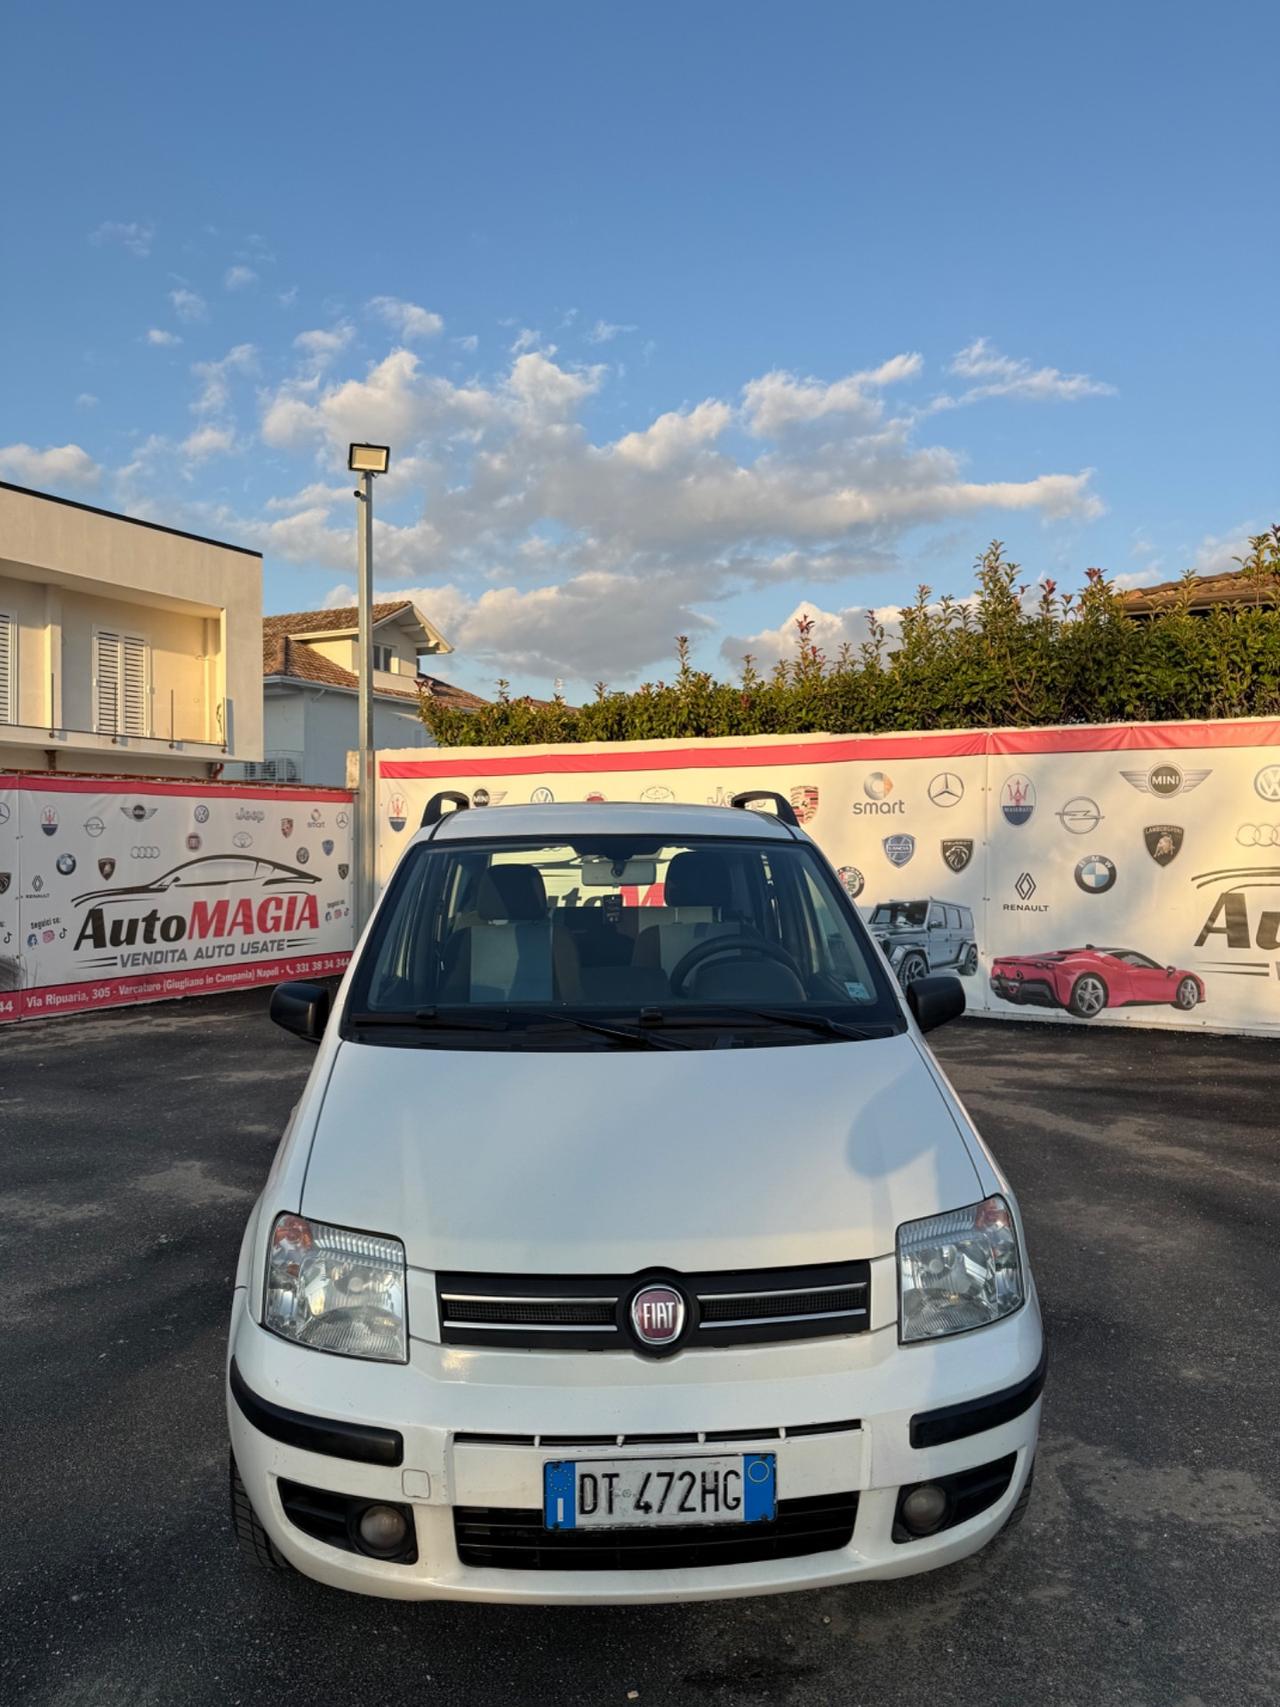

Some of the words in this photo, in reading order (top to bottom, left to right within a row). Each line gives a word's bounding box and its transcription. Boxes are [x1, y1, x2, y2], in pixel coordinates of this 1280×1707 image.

[1151, 775, 1180, 785] MINI
[853, 799, 905, 815] smart
[1003, 904, 1049, 912] RENAULT
[73, 894, 320, 951] AutoMAGIA
[119, 948, 188, 968] VENDITA
[195, 943, 234, 960] AUTO
[240, 939, 286, 956] USATE
[26, 995, 43, 1008] Via
[92, 987, 111, 999] 305
[206, 976, 213, 985] in
[257, 966, 279, 979] Napoli
[295, 962, 309, 973] 331
[643, 1302, 675, 1329] FIAT
[579, 1472, 620, 1515] DT
